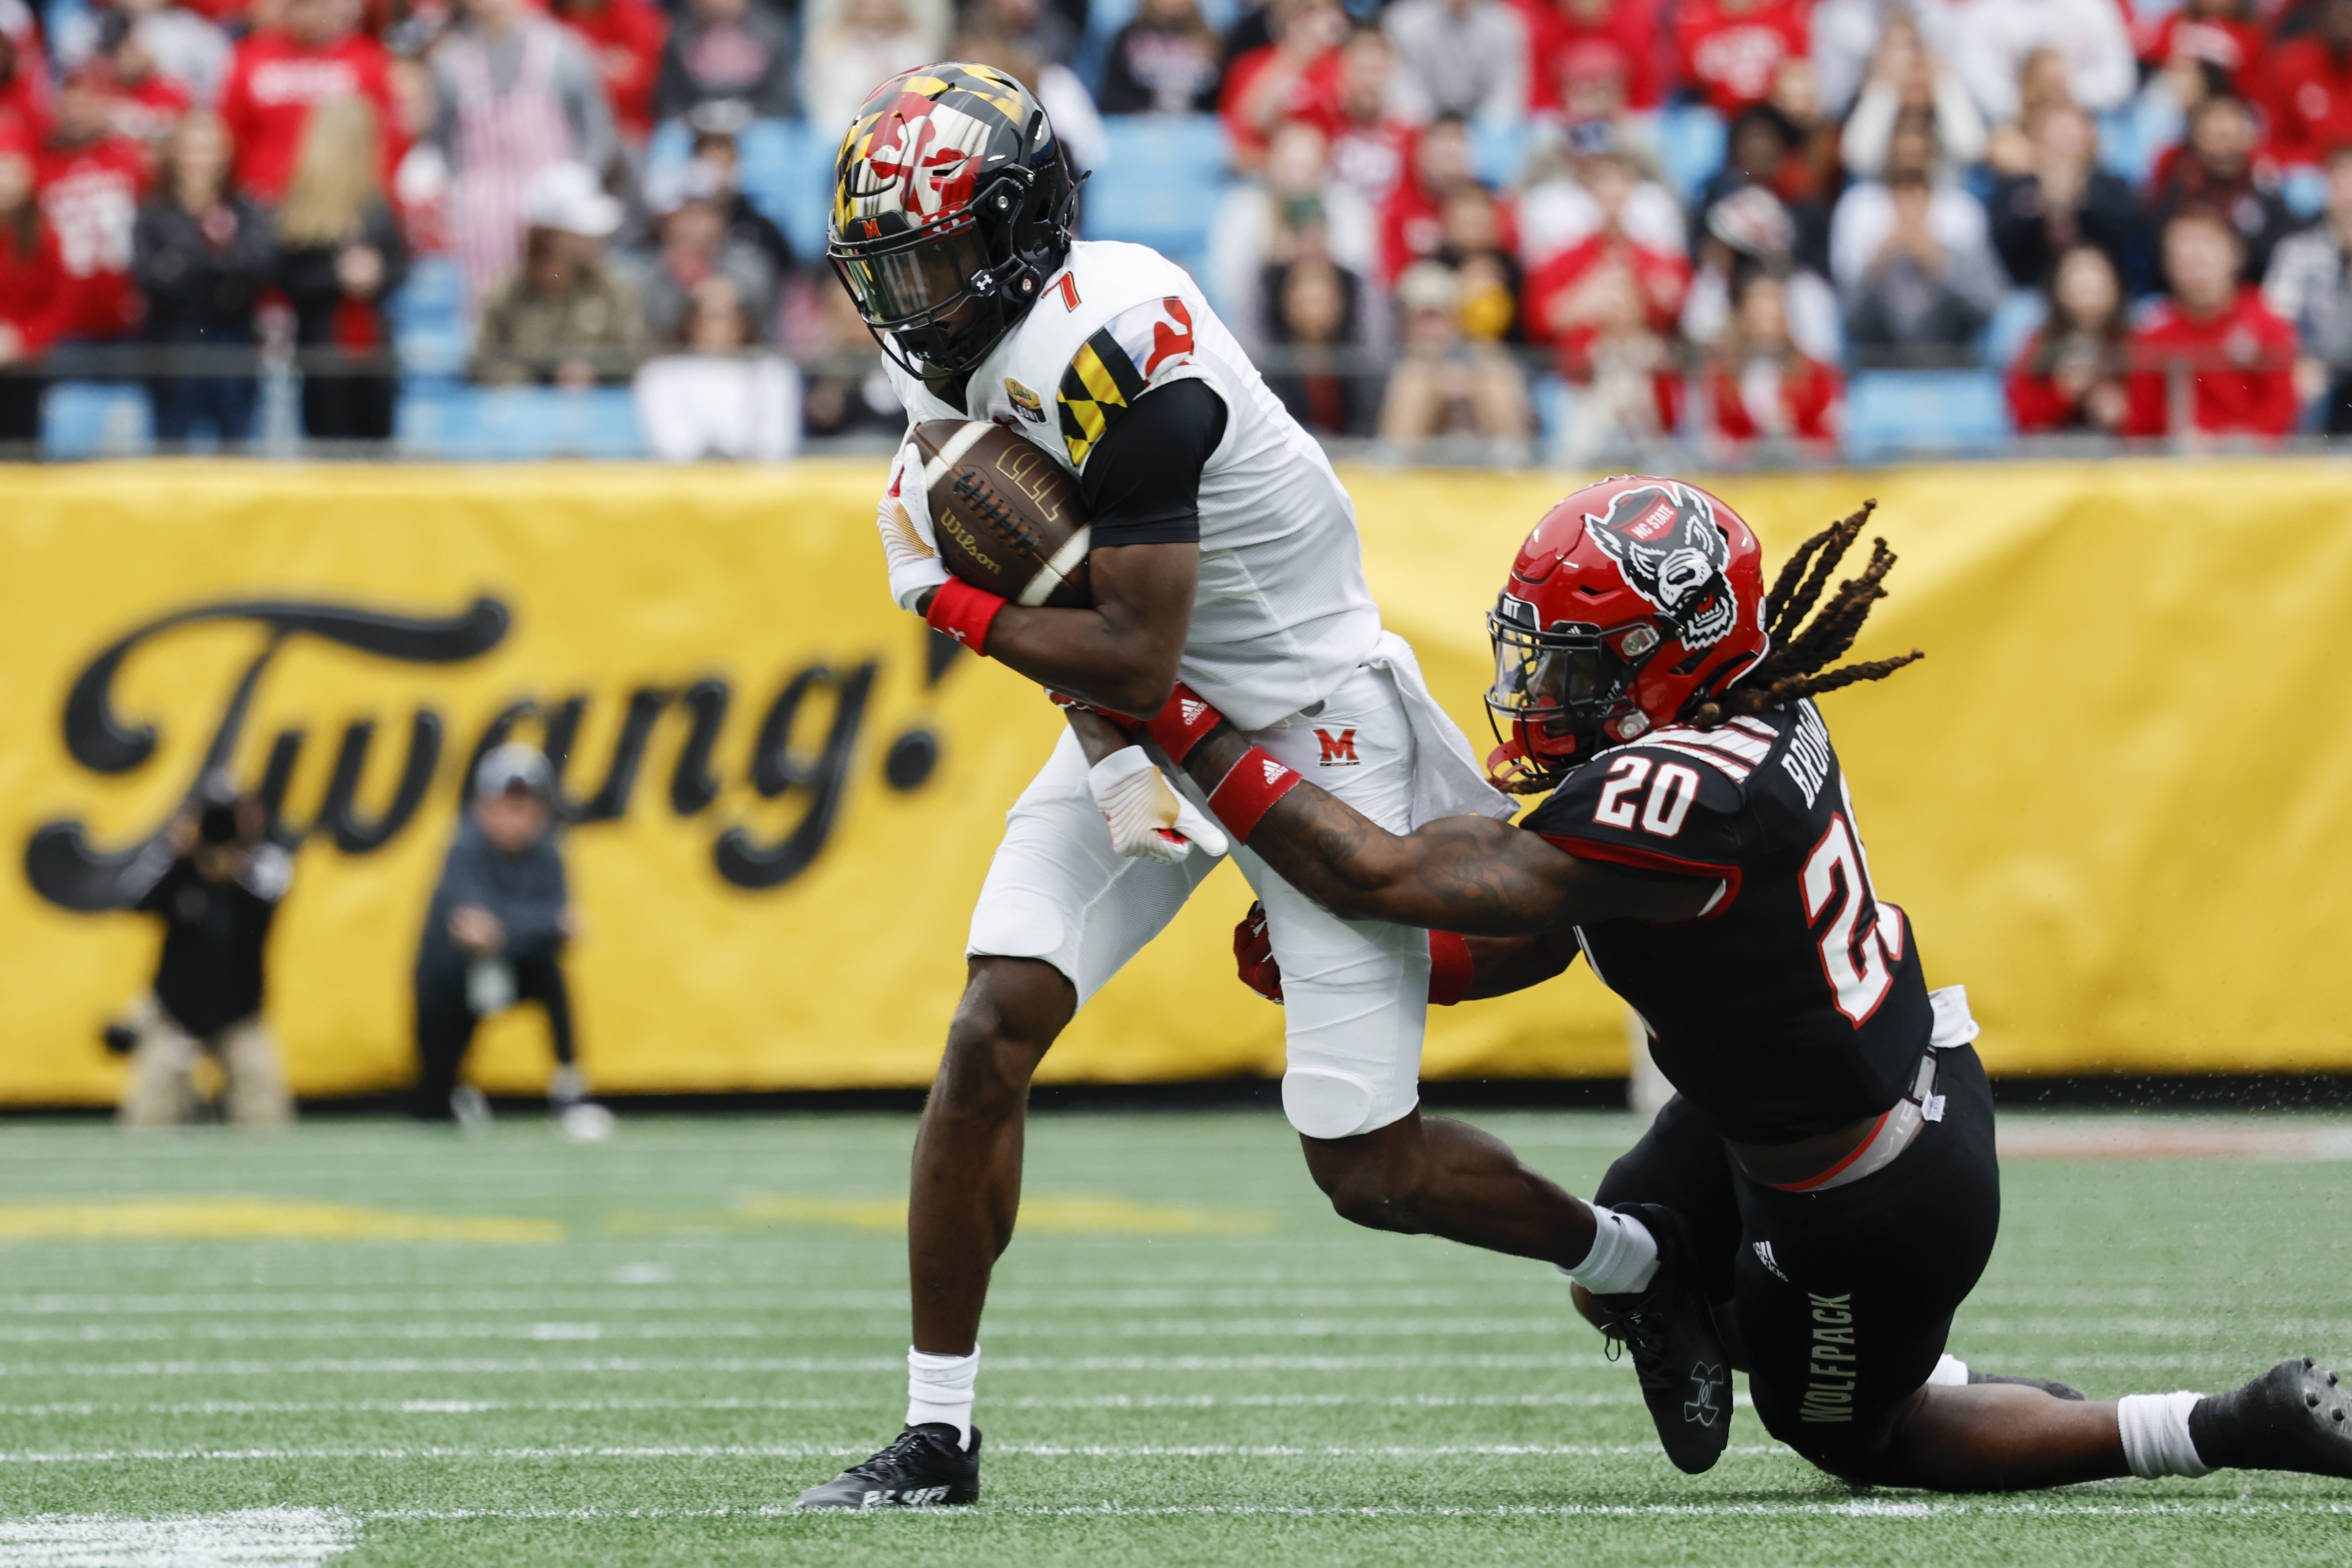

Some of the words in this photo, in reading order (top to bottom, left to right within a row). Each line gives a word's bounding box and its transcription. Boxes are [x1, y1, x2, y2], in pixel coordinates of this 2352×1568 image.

[861, 218, 882, 239] M
[1041, 270, 1082, 313] 7
[939, 507, 1001, 575] Wilson
[1631, 523, 1654, 539] NC
[1646, 503, 1675, 530] STATE
[1184, 701, 1209, 726] adidas
[25, 594, 966, 914] Twang!
[1313, 728, 1360, 761] M
[1780, 697, 1830, 810] BROWN
[1266, 765, 1290, 785] adidas
[1591, 754, 1701, 839] 20
[1800, 1292, 1856, 1423] WOLFPACK
